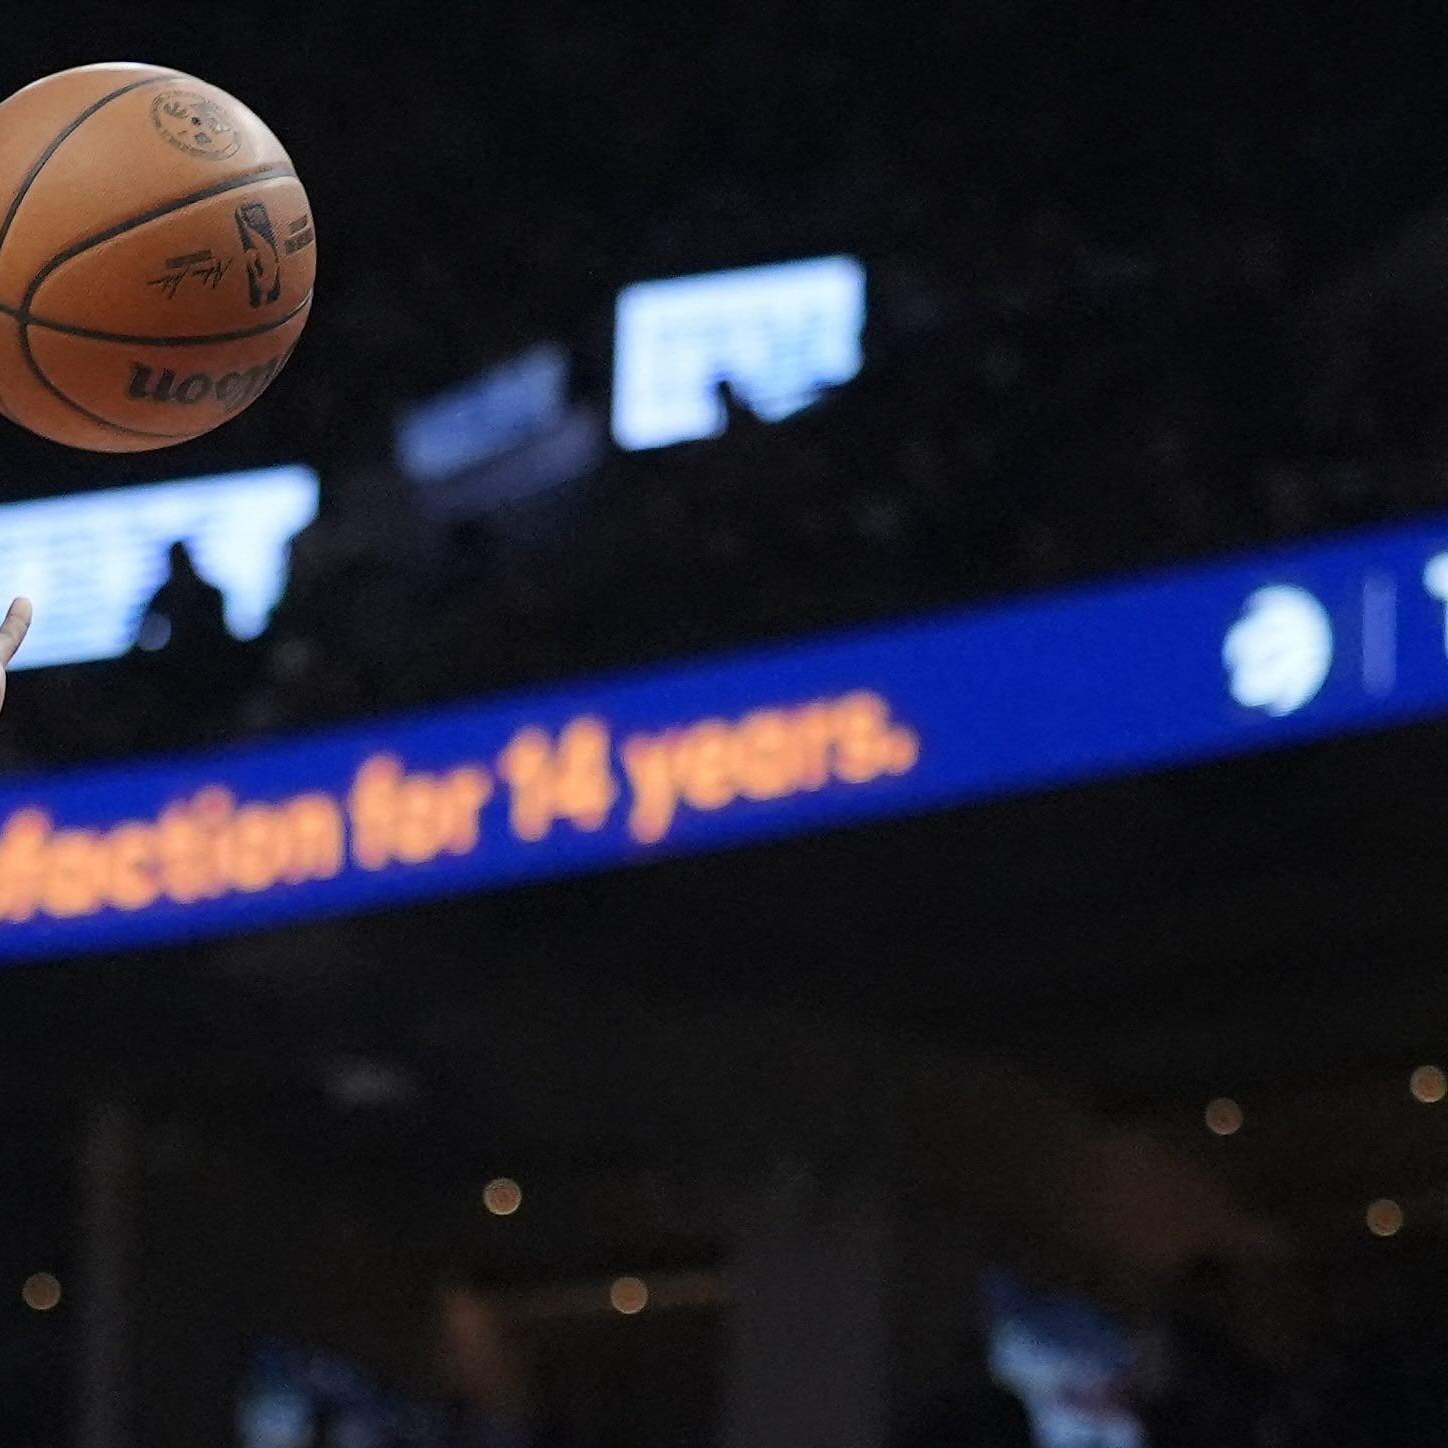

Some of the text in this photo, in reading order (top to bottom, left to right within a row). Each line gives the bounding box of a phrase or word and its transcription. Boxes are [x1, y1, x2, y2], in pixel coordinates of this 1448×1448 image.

[351, 751, 495, 871] for
[499, 713, 621, 843] 14
[621, 690, 920, 845] years.
